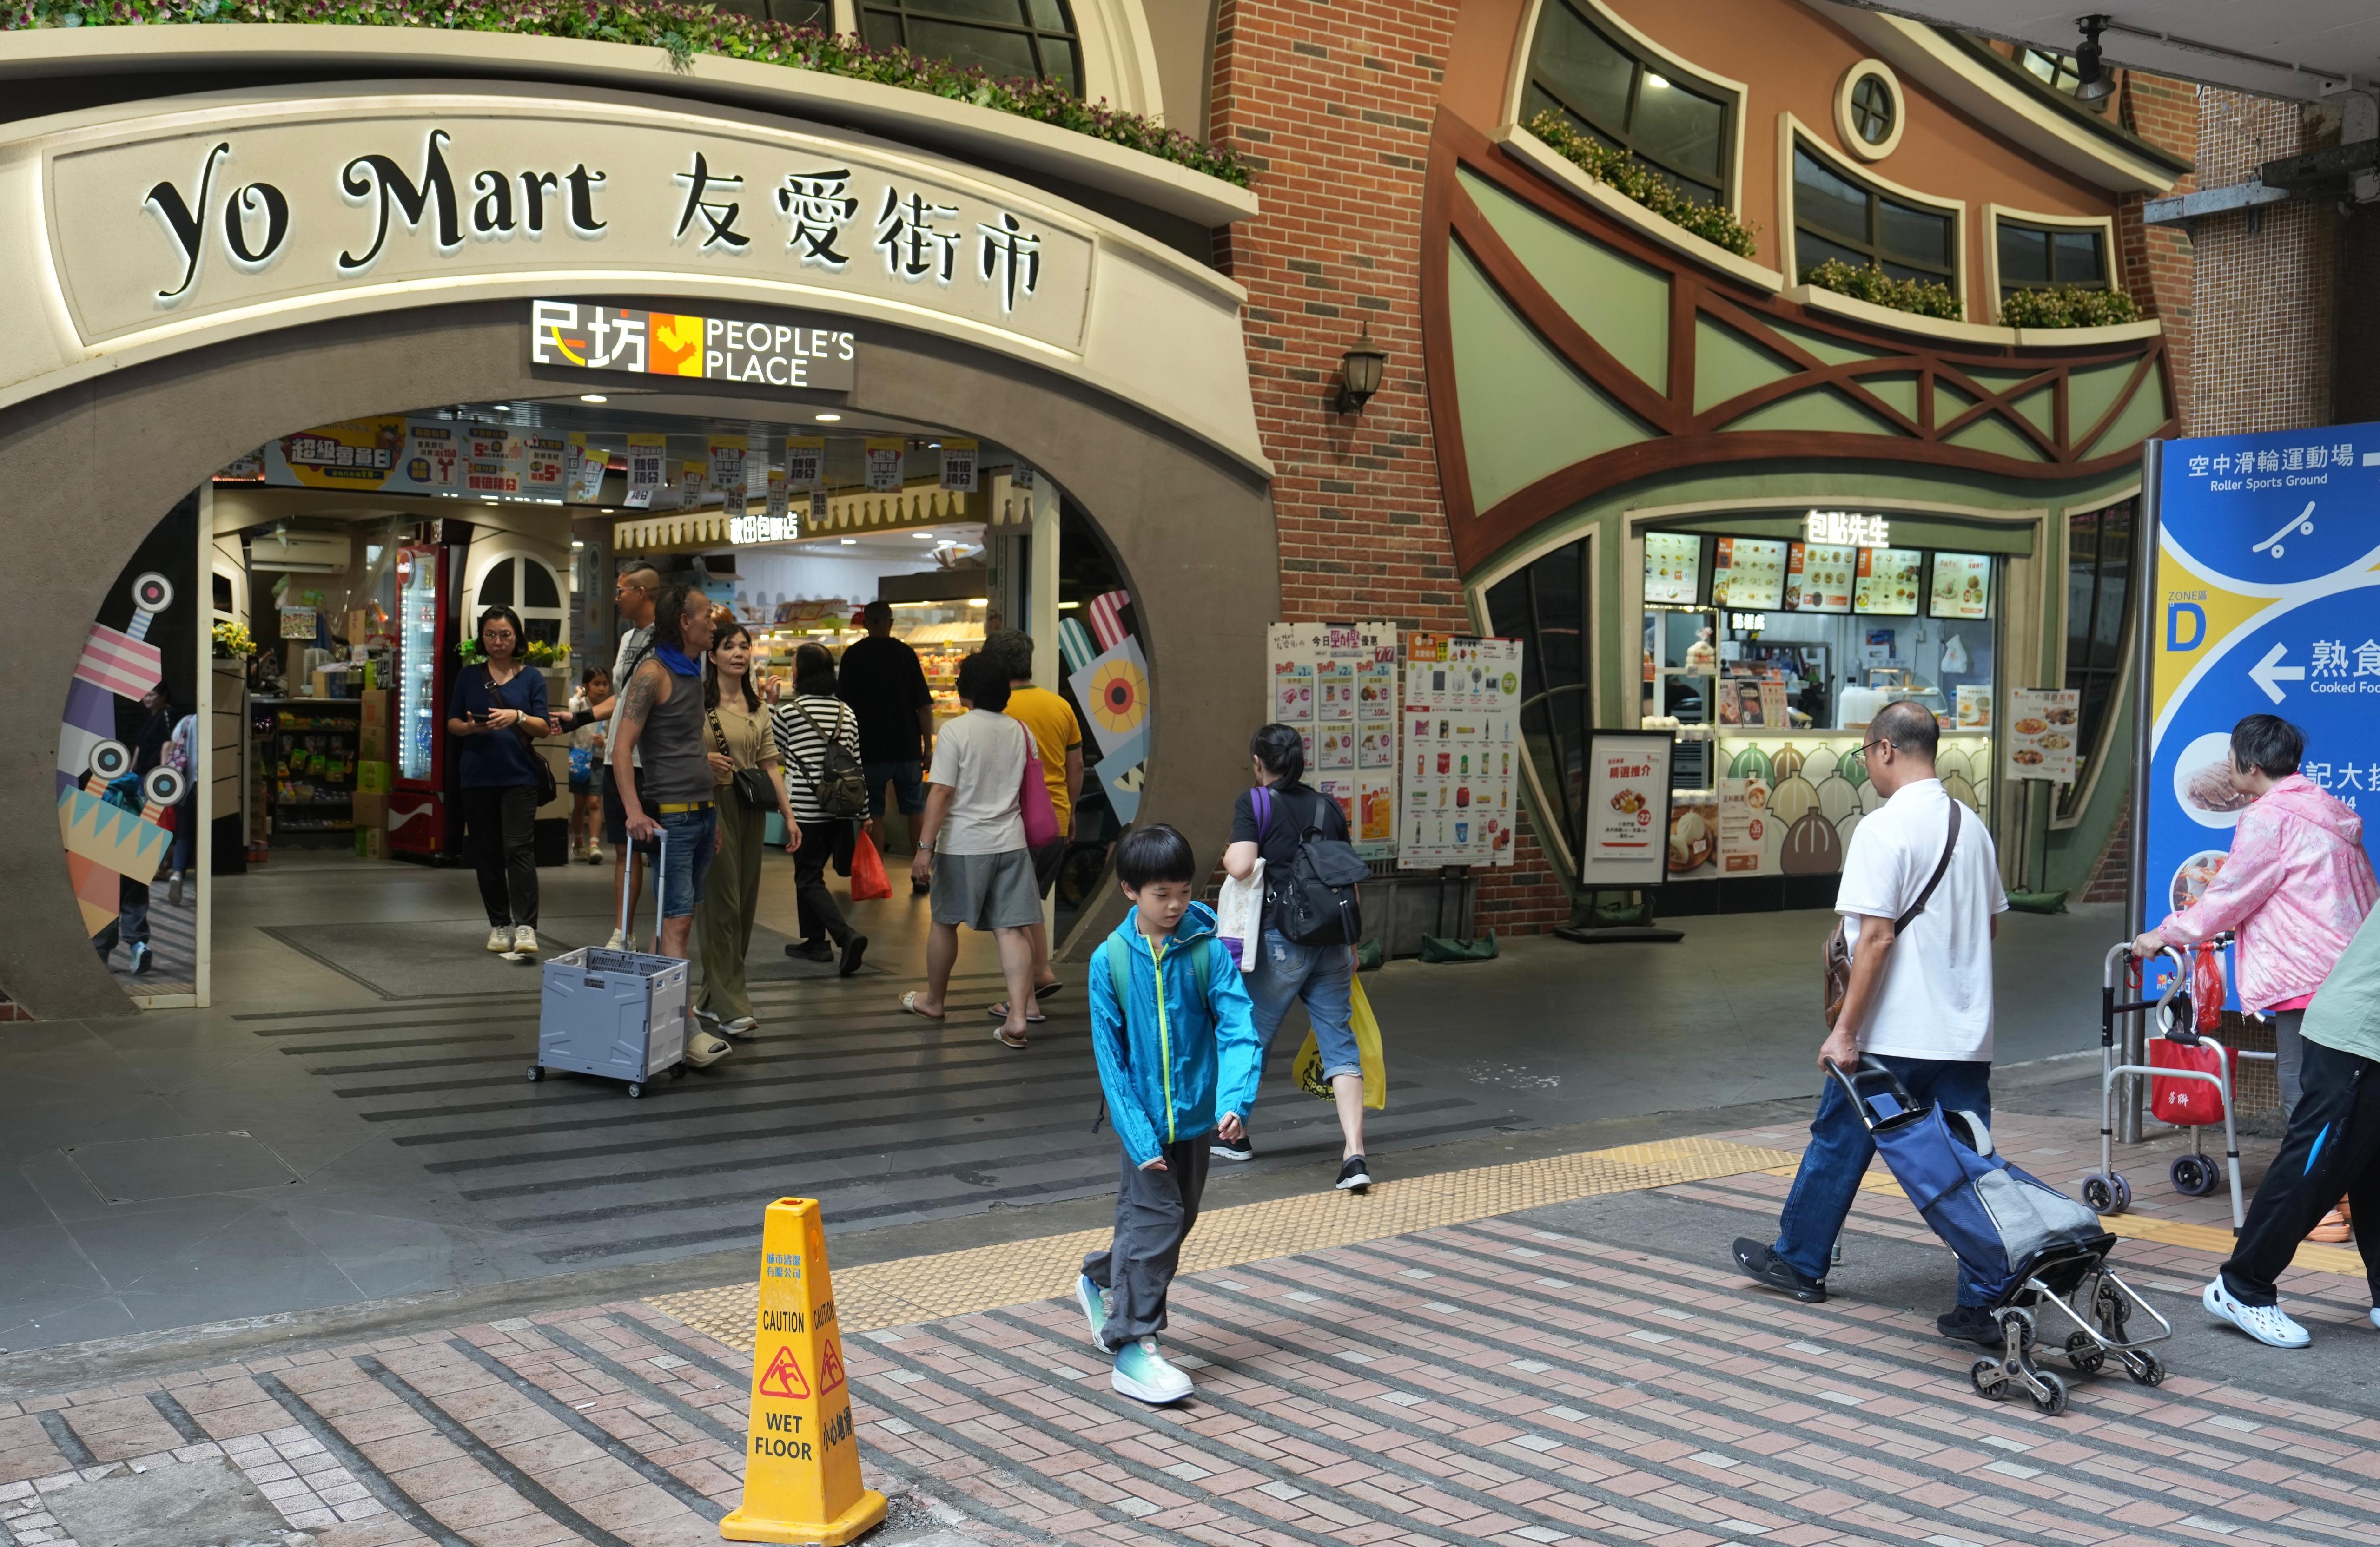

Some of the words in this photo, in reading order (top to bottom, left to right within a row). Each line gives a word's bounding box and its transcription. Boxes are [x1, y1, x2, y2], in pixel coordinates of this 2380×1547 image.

[338, 129, 607, 269] Mart
[675, 151, 1040, 312] 友愛街市
[533, 299, 645, 372] 民坊
[707, 318, 854, 360] PEOPLE'S
[707, 350, 807, 387] PLACE
[291, 438, 391, 468] 超級會員日
[792, 458, 816, 468] 雙倍
[2188, 443, 2354, 478] 空中滑輪運動場
[634, 458, 659, 471] 雙倍
[791, 468, 816, 479] 積分
[947, 461, 971, 472] 雙倍
[469, 476, 517, 491] 雙倍積分
[634, 471, 659, 484] 積分
[946, 472, 971, 484] 積分
[2210, 479, 2241, 491] Roller
[2246, 477, 2282, 492] Sports
[2285, 473, 2327, 487] Ground
[729, 511, 798, 545] 秋田包餅店
[1807, 508, 1889, 548] 包點先生
[2168, 590, 2208, 601] ZONE區
[2166, 602, 2207, 652] D
[1376, 647, 1394, 661] 77
[2311, 639, 2380, 678] 熟食
[2310, 681, 2356, 693] Cooked
[1610, 764, 1651, 779] 精選推介
[767, 1253, 801, 1266] 城市清潔
[767, 1266, 801, 1279] 有限公司
[763, 1310, 804, 1333] CAUTION
[813, 1299, 834, 1330] CAUTION
[766, 1412, 803, 1433] WET
[823, 1405, 853, 1453] 小心地滑
[755, 1436, 812, 1461] FLOOR
